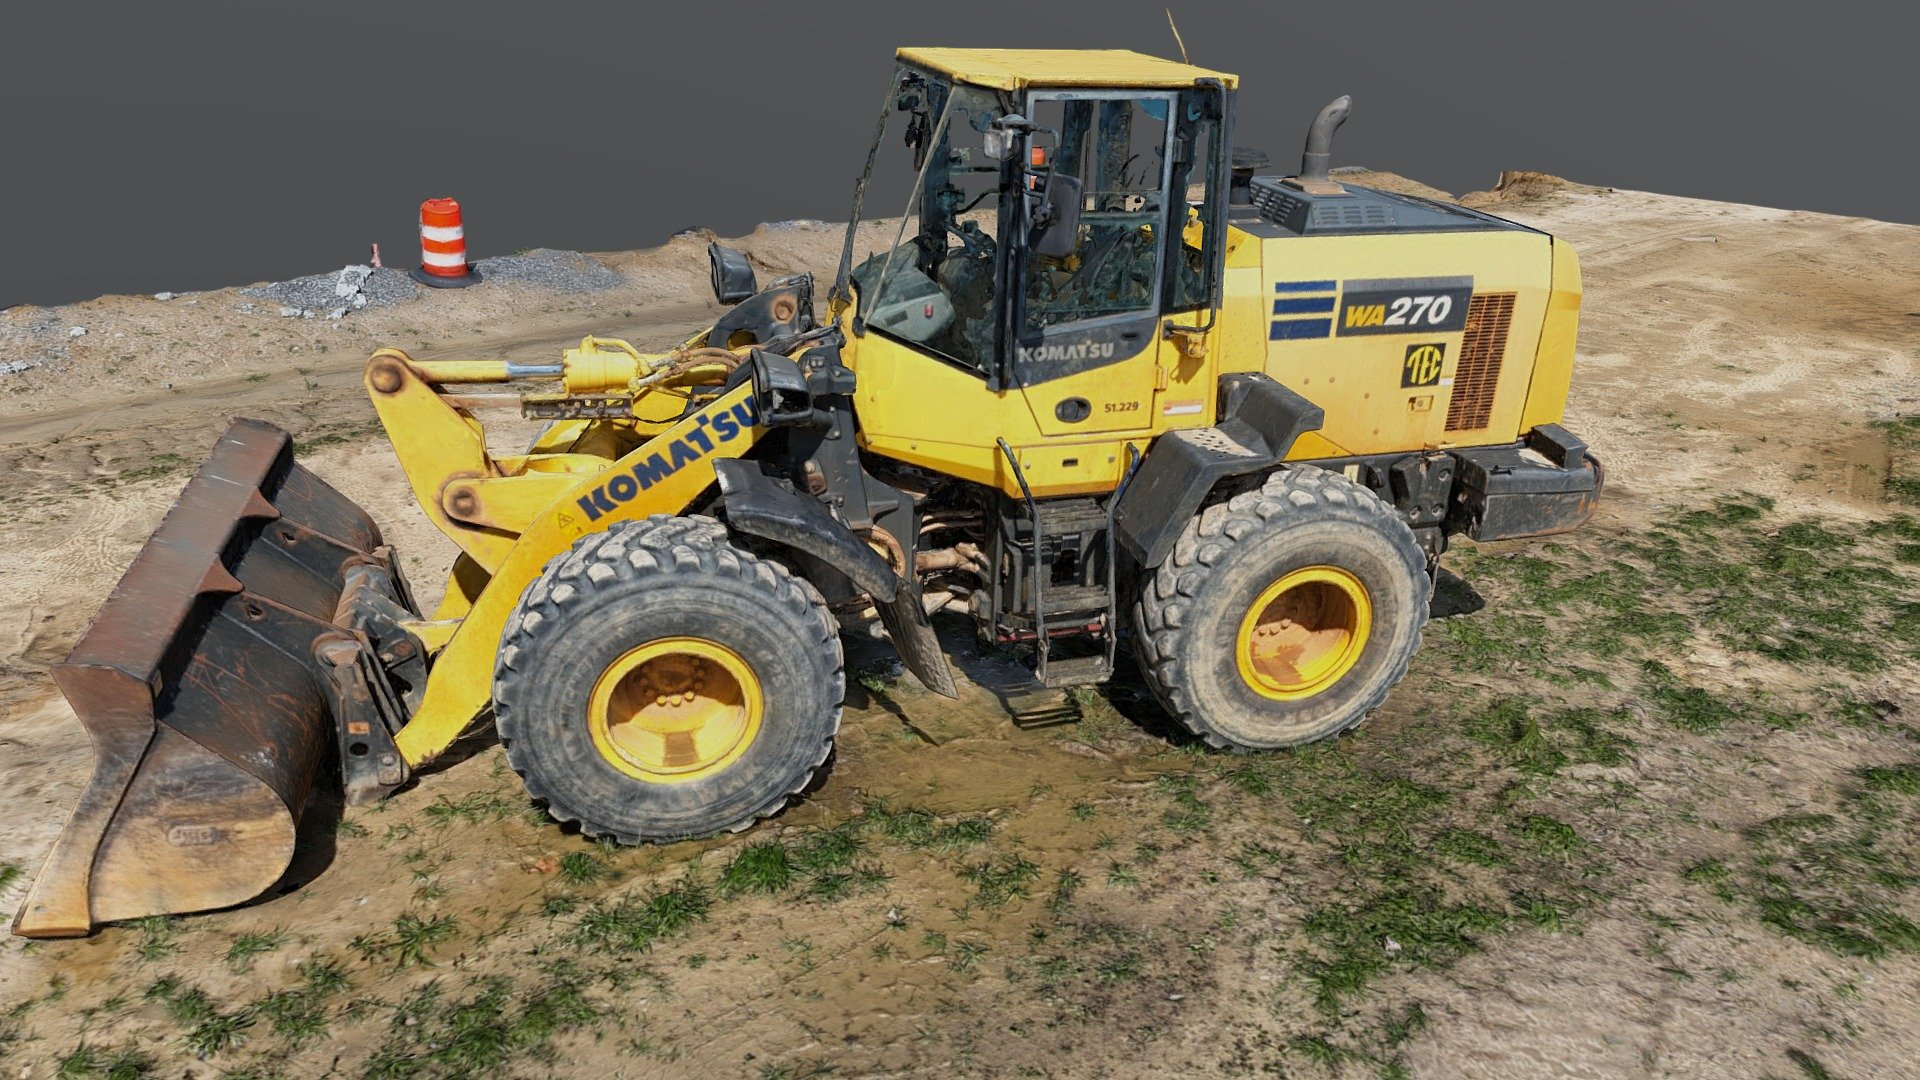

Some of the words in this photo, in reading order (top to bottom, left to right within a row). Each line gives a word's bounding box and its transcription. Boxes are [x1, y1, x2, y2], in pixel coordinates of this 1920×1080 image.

[1018, 342, 1115, 363] KOMATSU
[1407, 345, 1442, 385] TEC
[577, 396, 759, 522] KOMATSU
